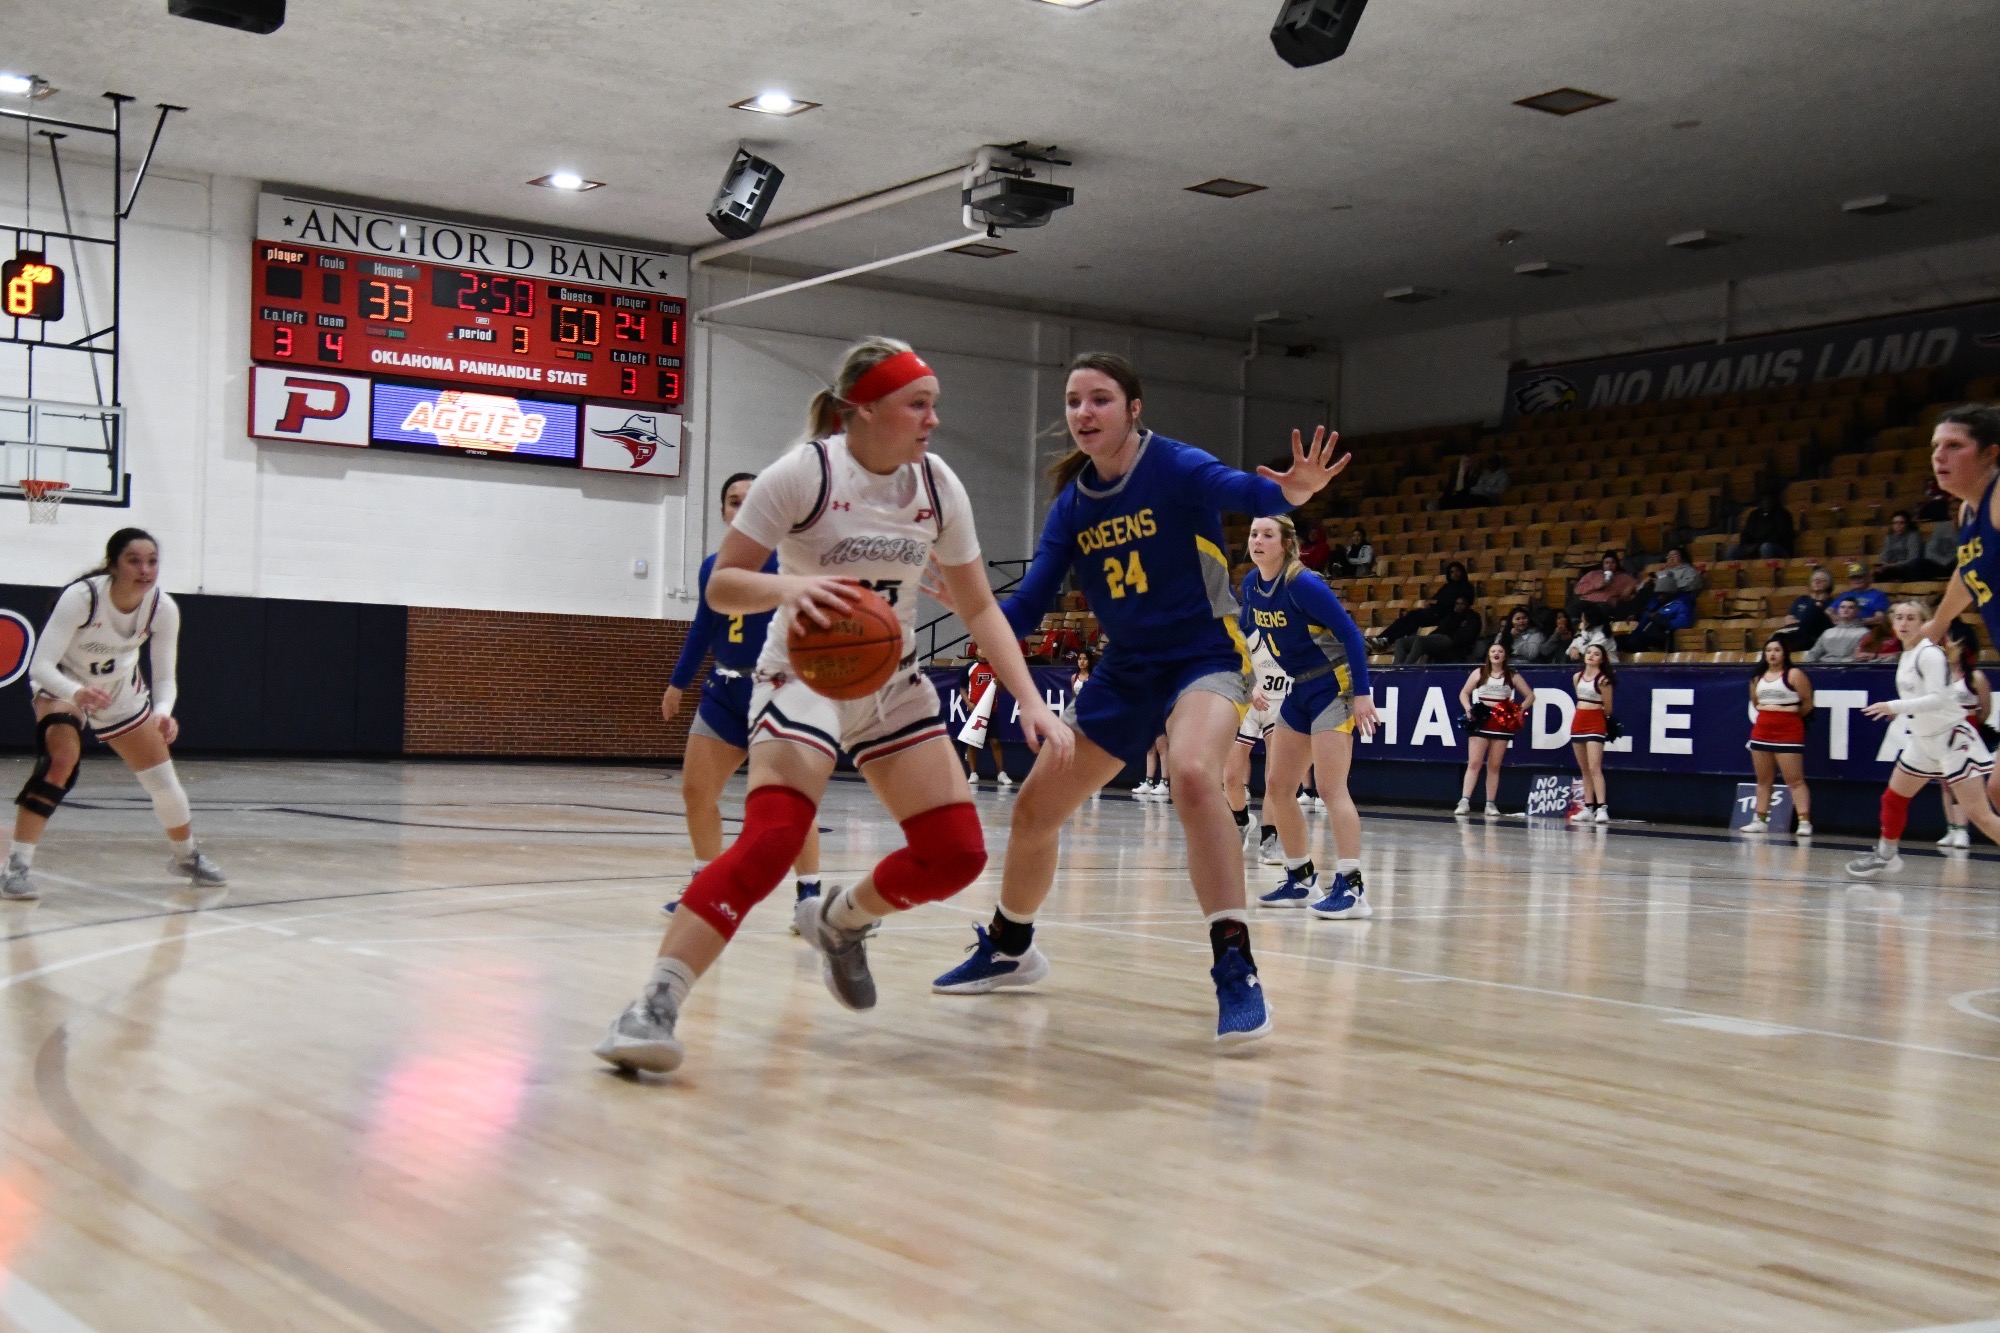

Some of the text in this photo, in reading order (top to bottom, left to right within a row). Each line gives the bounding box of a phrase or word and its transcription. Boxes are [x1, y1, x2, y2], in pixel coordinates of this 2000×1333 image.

[267, 247, 304, 263] player
[297, 208, 656, 288] ANCHOR D BANK
[319, 255, 345, 270] fouls
[374, 262, 403, 279] Home
[369, 281, 414, 323] 33
[560, 288, 593, 304] Guests
[616, 296, 646, 310] player
[659, 301, 681, 315] fouls
[318, 314, 344, 328] team
[458, 328, 492, 341] period
[560, 306, 601, 346] 60
[615, 312, 645, 340] 24
[275, 327, 292, 357] 3
[325, 333, 344, 361] 4
[514, 326, 529, 354] 3
[371, 349, 588, 386] OKLAHOMA PANHANDLE STATE
[658, 356, 680, 368] team
[1588, 326, 1960, 410] NO MANS LAND
[622, 368, 637, 394] 3
[665, 372, 679, 399] 3
[403, 403, 545, 441] AGGIES
[1077, 508, 1157, 555] QUEENS
[820, 535, 928, 567] AGGIES
[1103, 550, 1149, 600] 24
[727, 613, 744, 643] 2
[1263, 675, 1286, 691] 30
[1527, 785, 1571, 804] MAN'S
[1536, 775, 1558, 790] NO
[1527, 799, 1567, 816] LAND
